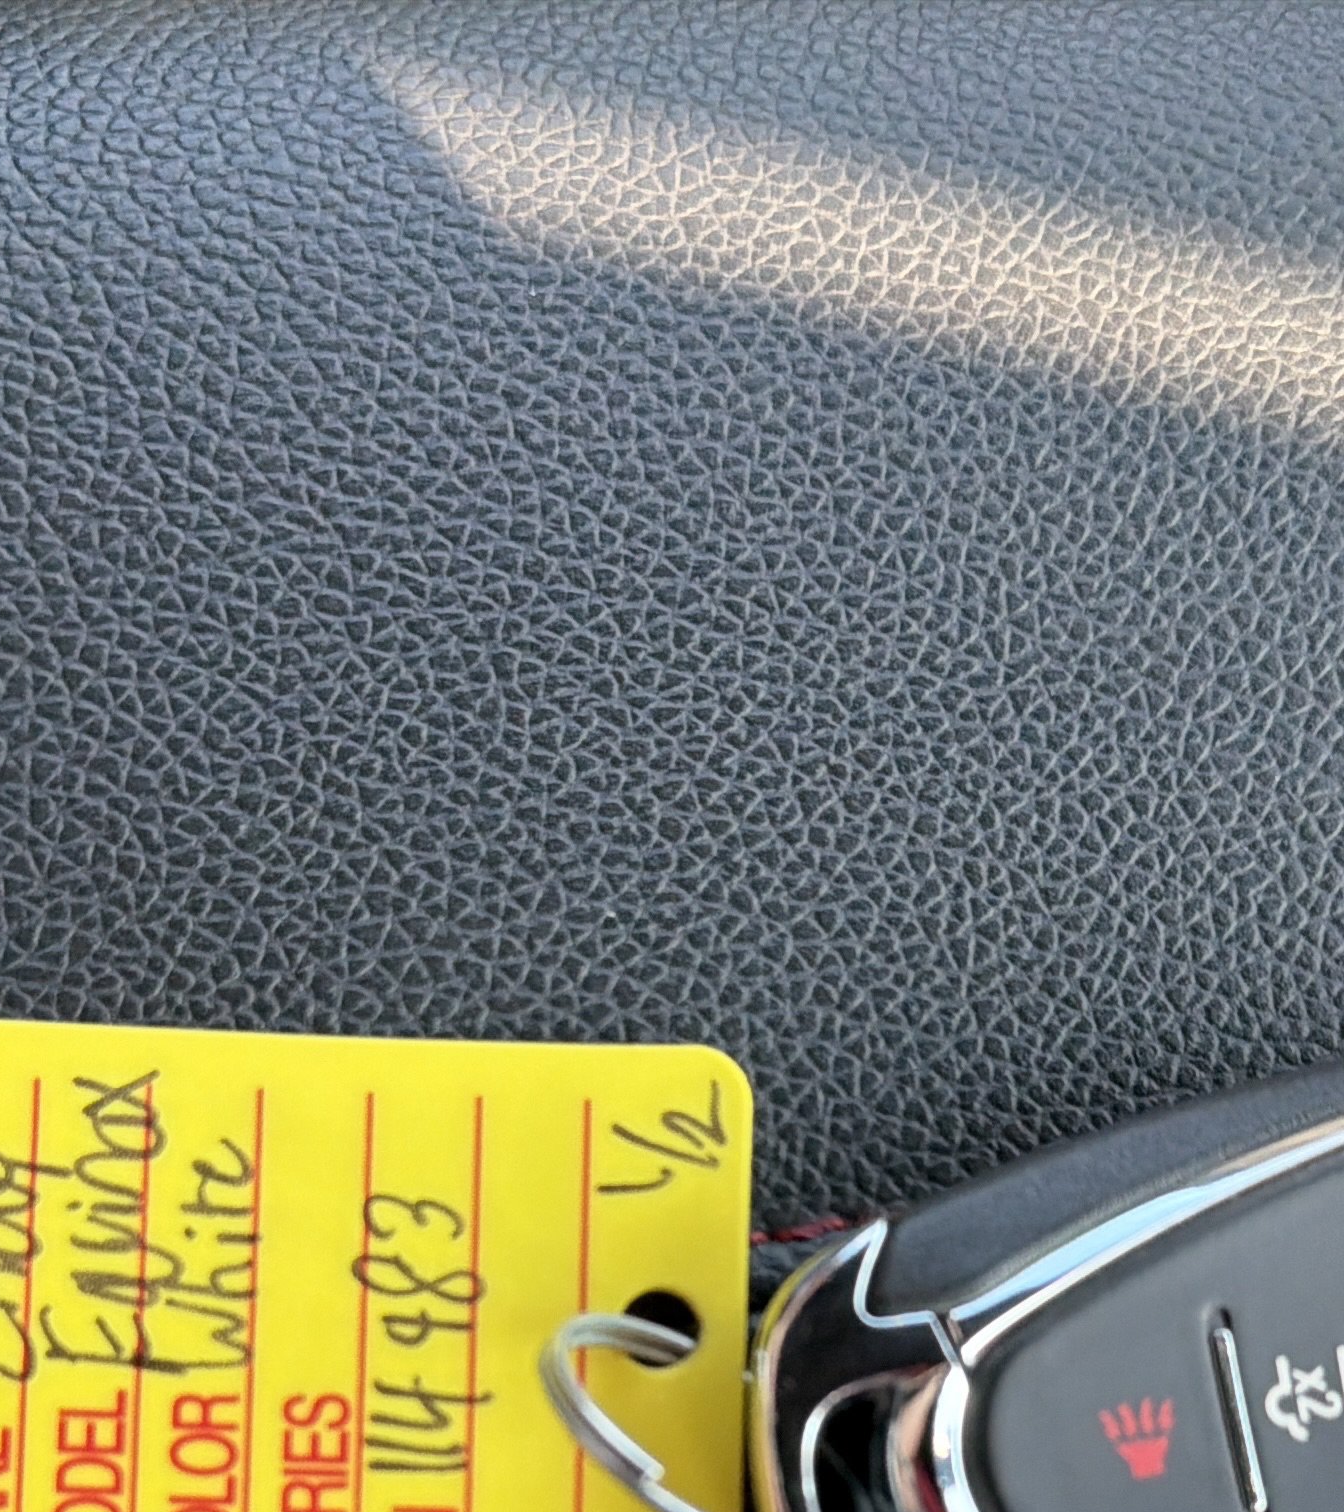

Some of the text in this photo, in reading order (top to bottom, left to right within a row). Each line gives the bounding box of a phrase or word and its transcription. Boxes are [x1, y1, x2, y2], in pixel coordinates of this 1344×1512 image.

[39, 1069, 187, 1374] Equinox
[156, 1138, 261, 1371] White
[597, 1080, 728, 1196] 1/2
